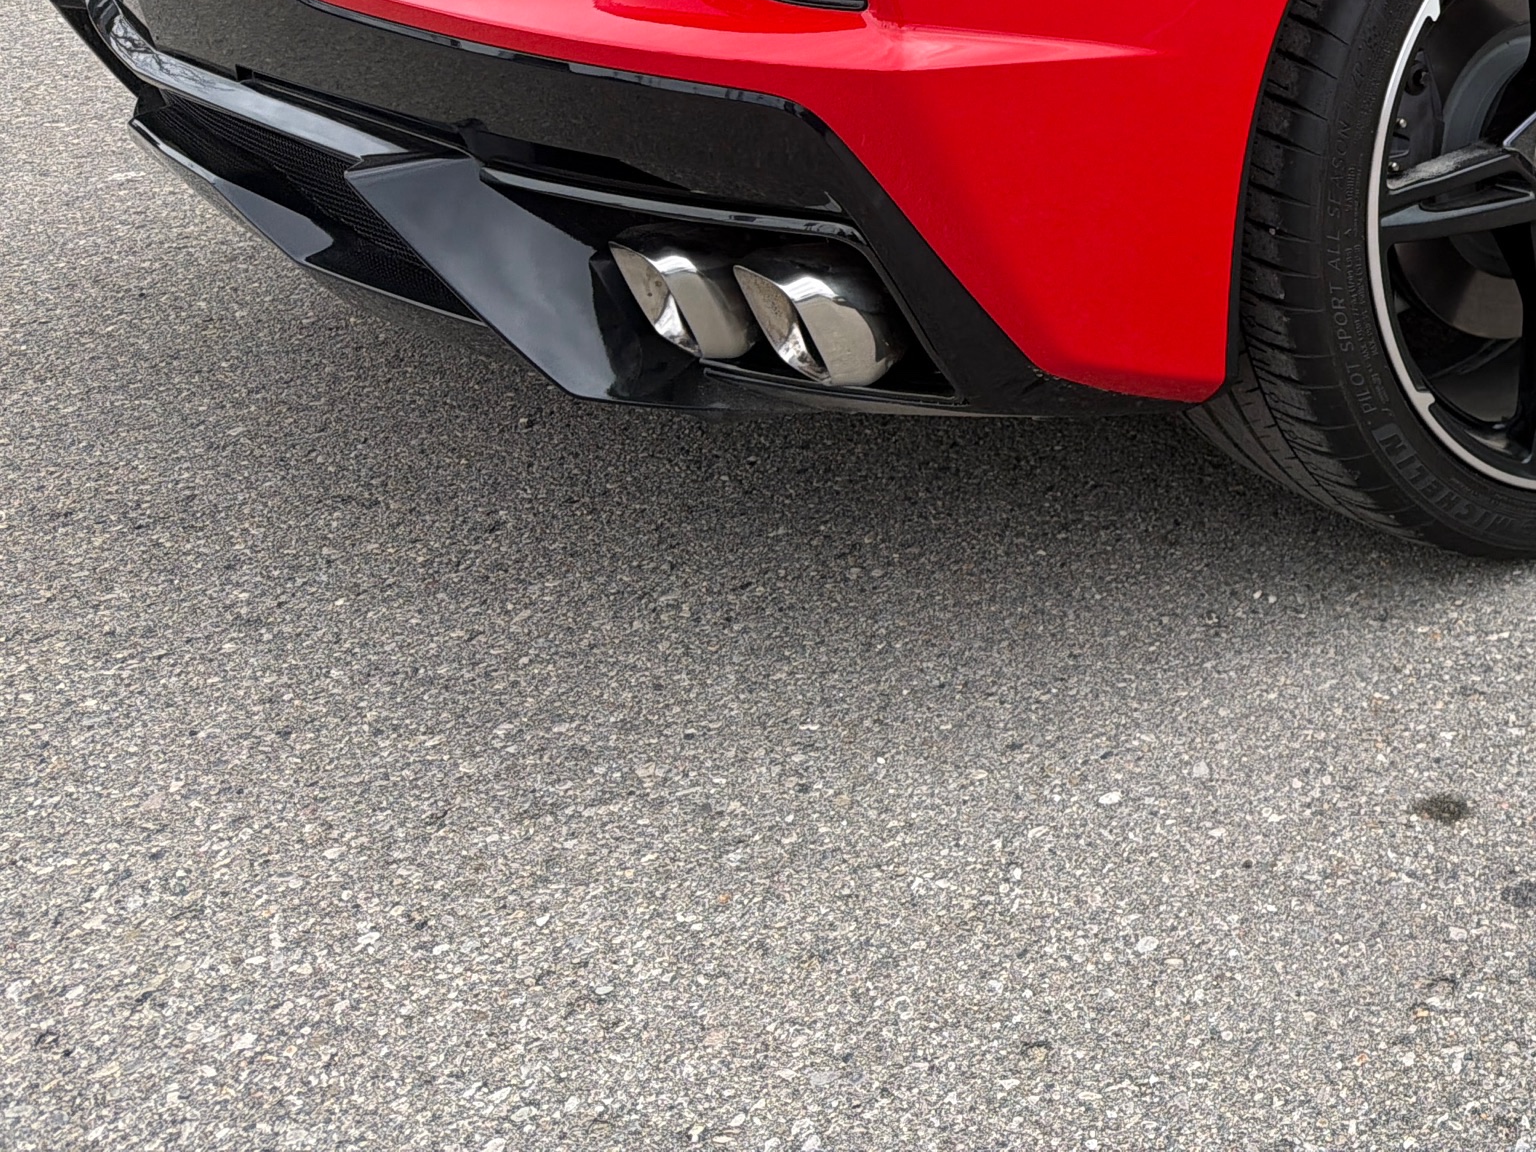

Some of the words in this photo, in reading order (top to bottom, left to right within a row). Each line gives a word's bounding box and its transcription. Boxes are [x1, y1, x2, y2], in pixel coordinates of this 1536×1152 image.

[1327, 120, 1351, 219] SEASON
[1326, 230, 1342, 272] ALL
[1331, 282, 1355, 353] SPORT
[1345, 363, 1378, 415] PILOT
[1378, 432, 1514, 535] MICHELIN
